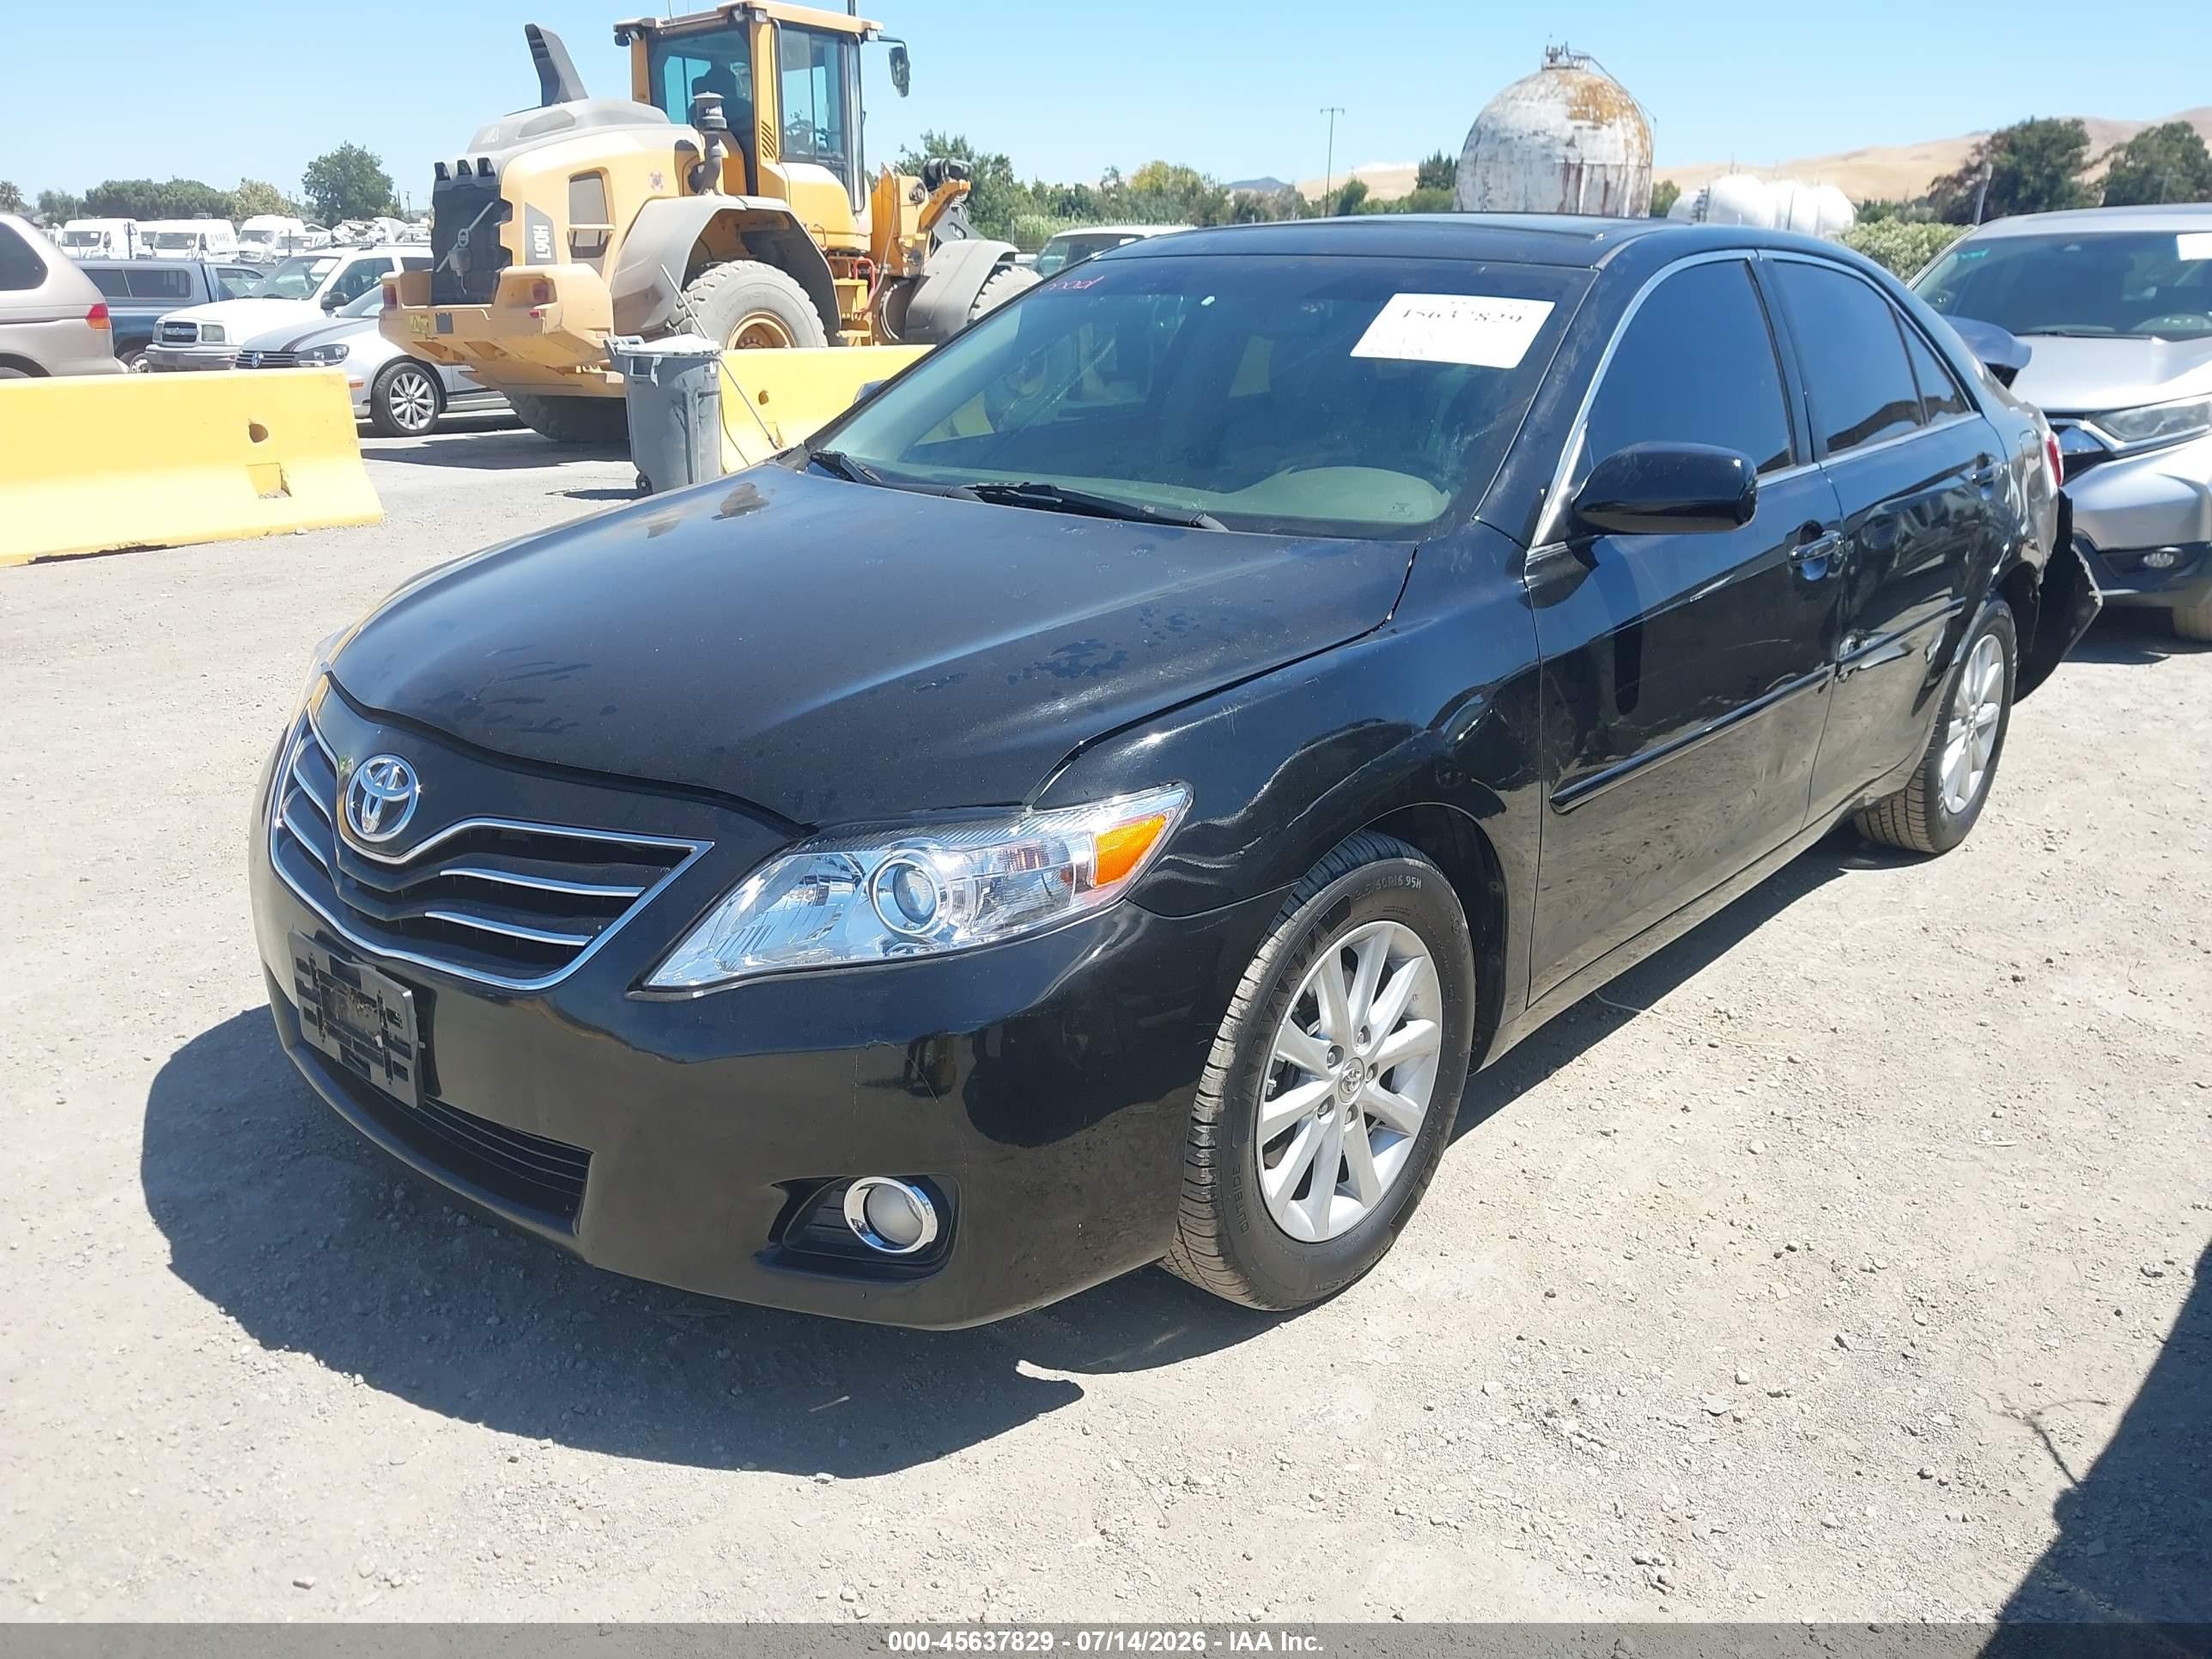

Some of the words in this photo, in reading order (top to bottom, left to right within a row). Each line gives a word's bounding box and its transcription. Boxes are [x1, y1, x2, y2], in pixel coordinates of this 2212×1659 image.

[532, 224, 552, 259] L90H
[1406, 874, 1422, 890] 95H
[1231, 1164, 1249, 1235] OUTSIDE
